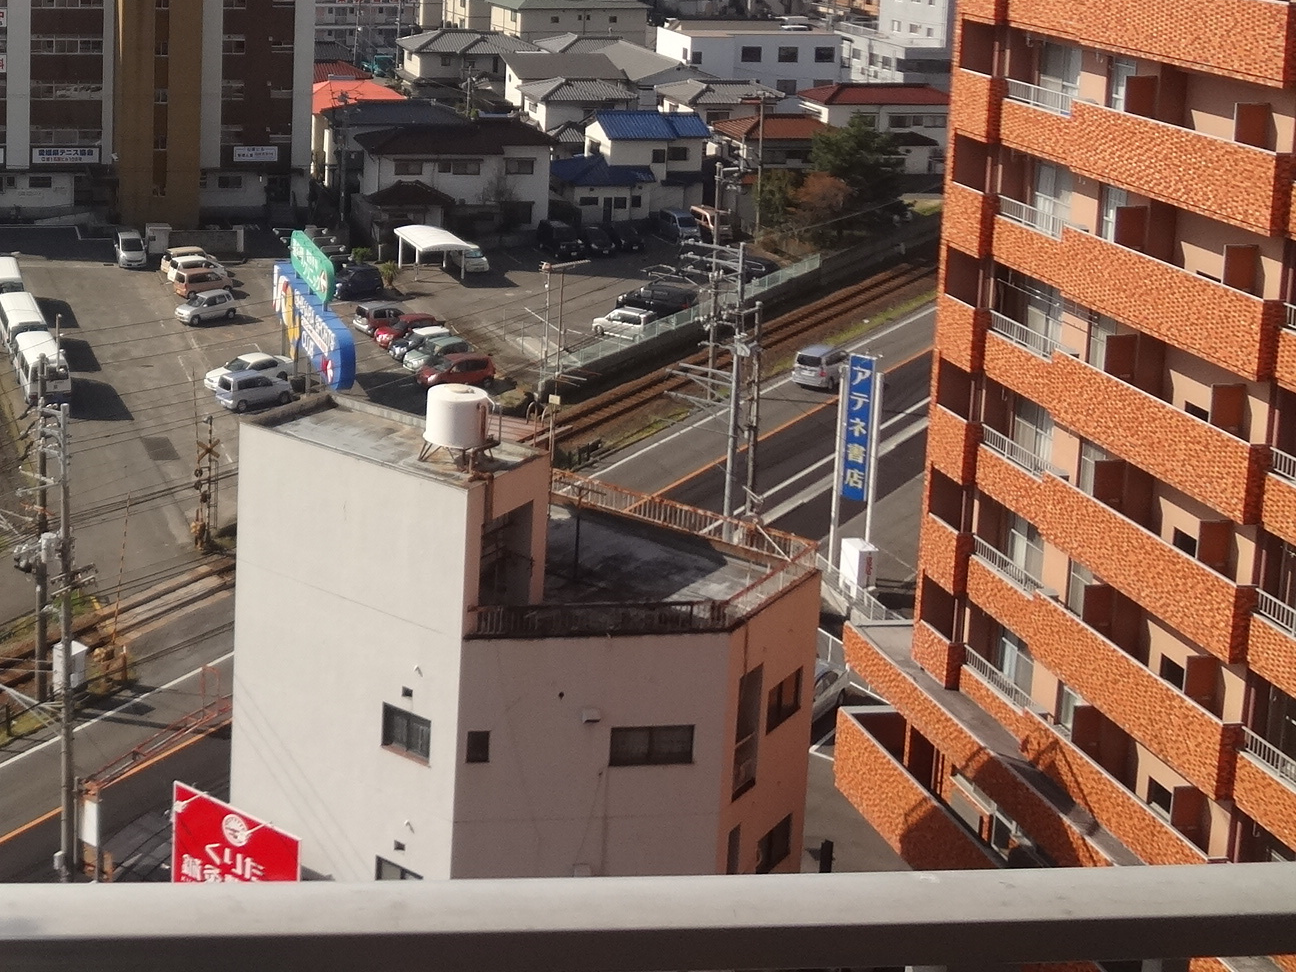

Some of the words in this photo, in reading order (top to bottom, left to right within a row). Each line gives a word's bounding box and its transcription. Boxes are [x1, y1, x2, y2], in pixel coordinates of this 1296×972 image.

[845, 366, 872, 489] アテネ書店
